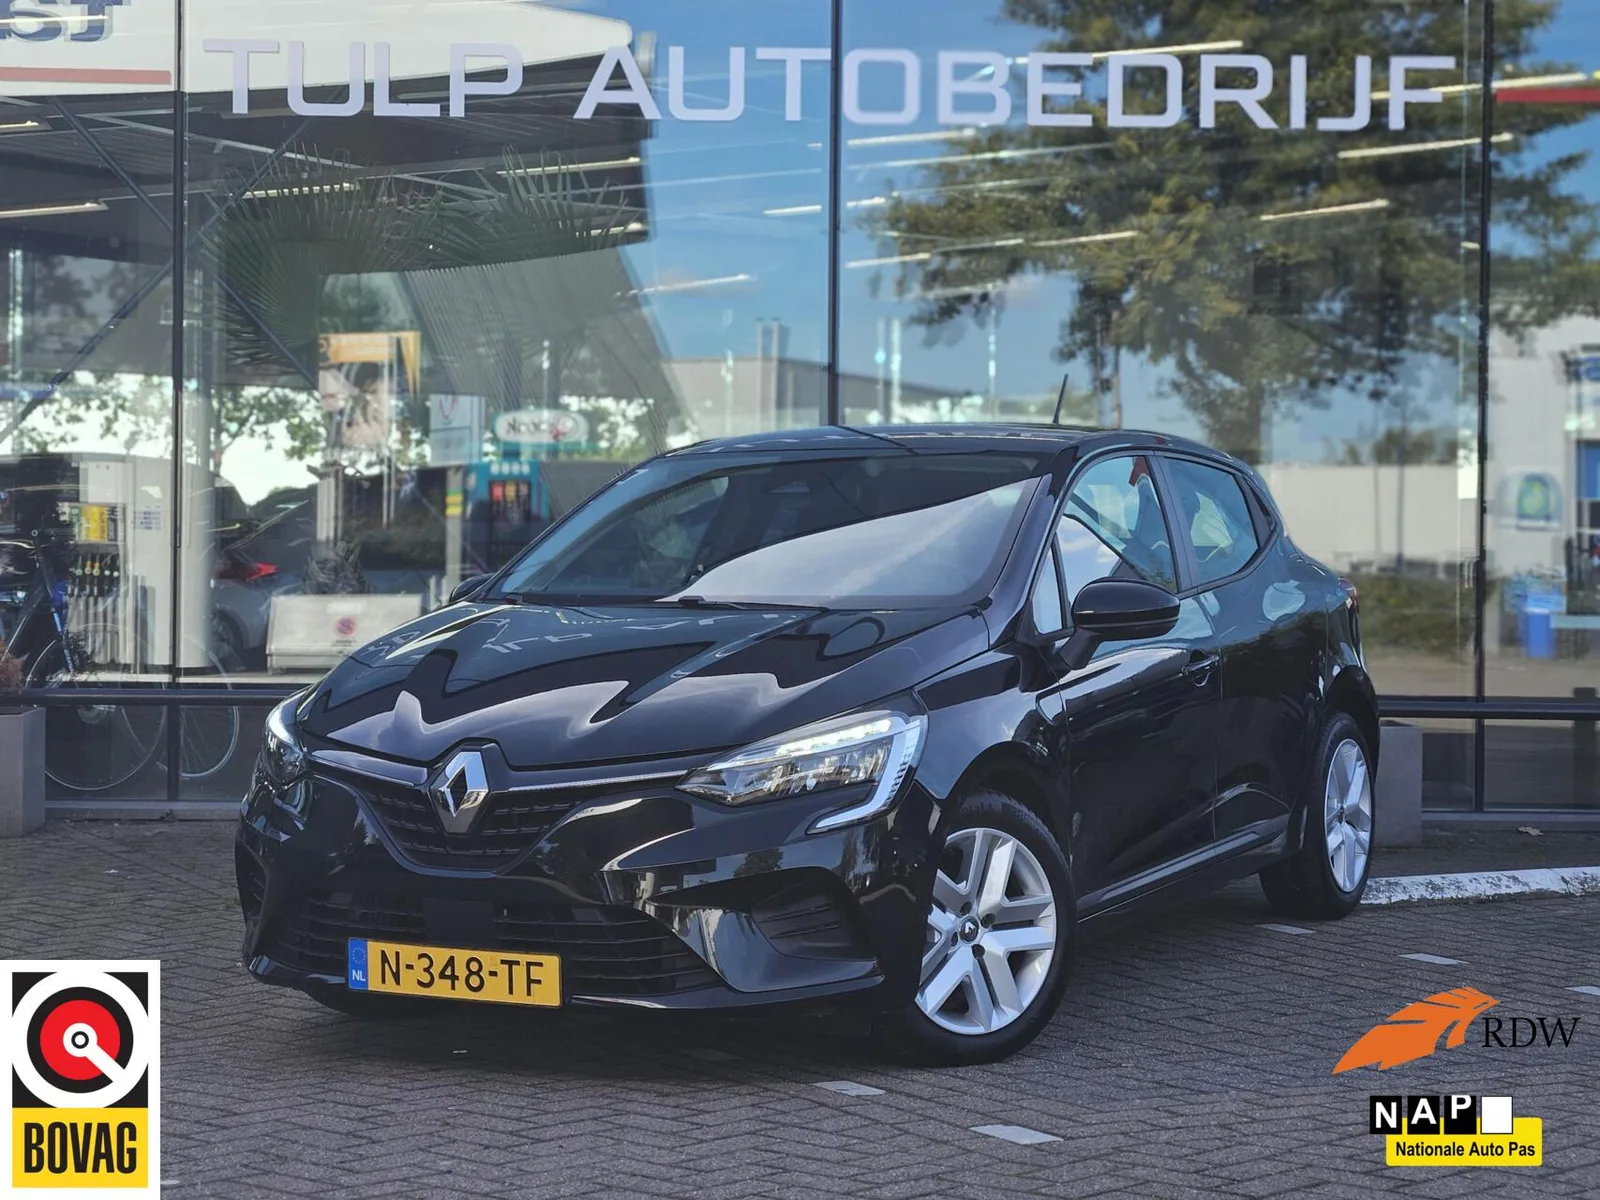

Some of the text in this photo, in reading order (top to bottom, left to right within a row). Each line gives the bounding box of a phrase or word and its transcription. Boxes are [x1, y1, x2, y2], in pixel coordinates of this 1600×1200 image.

[203, 39, 1456, 131] TULP AUTOBEDRIJF
[352, 969, 366, 982] NL
[380, 949, 543, 997] N-348-TF
